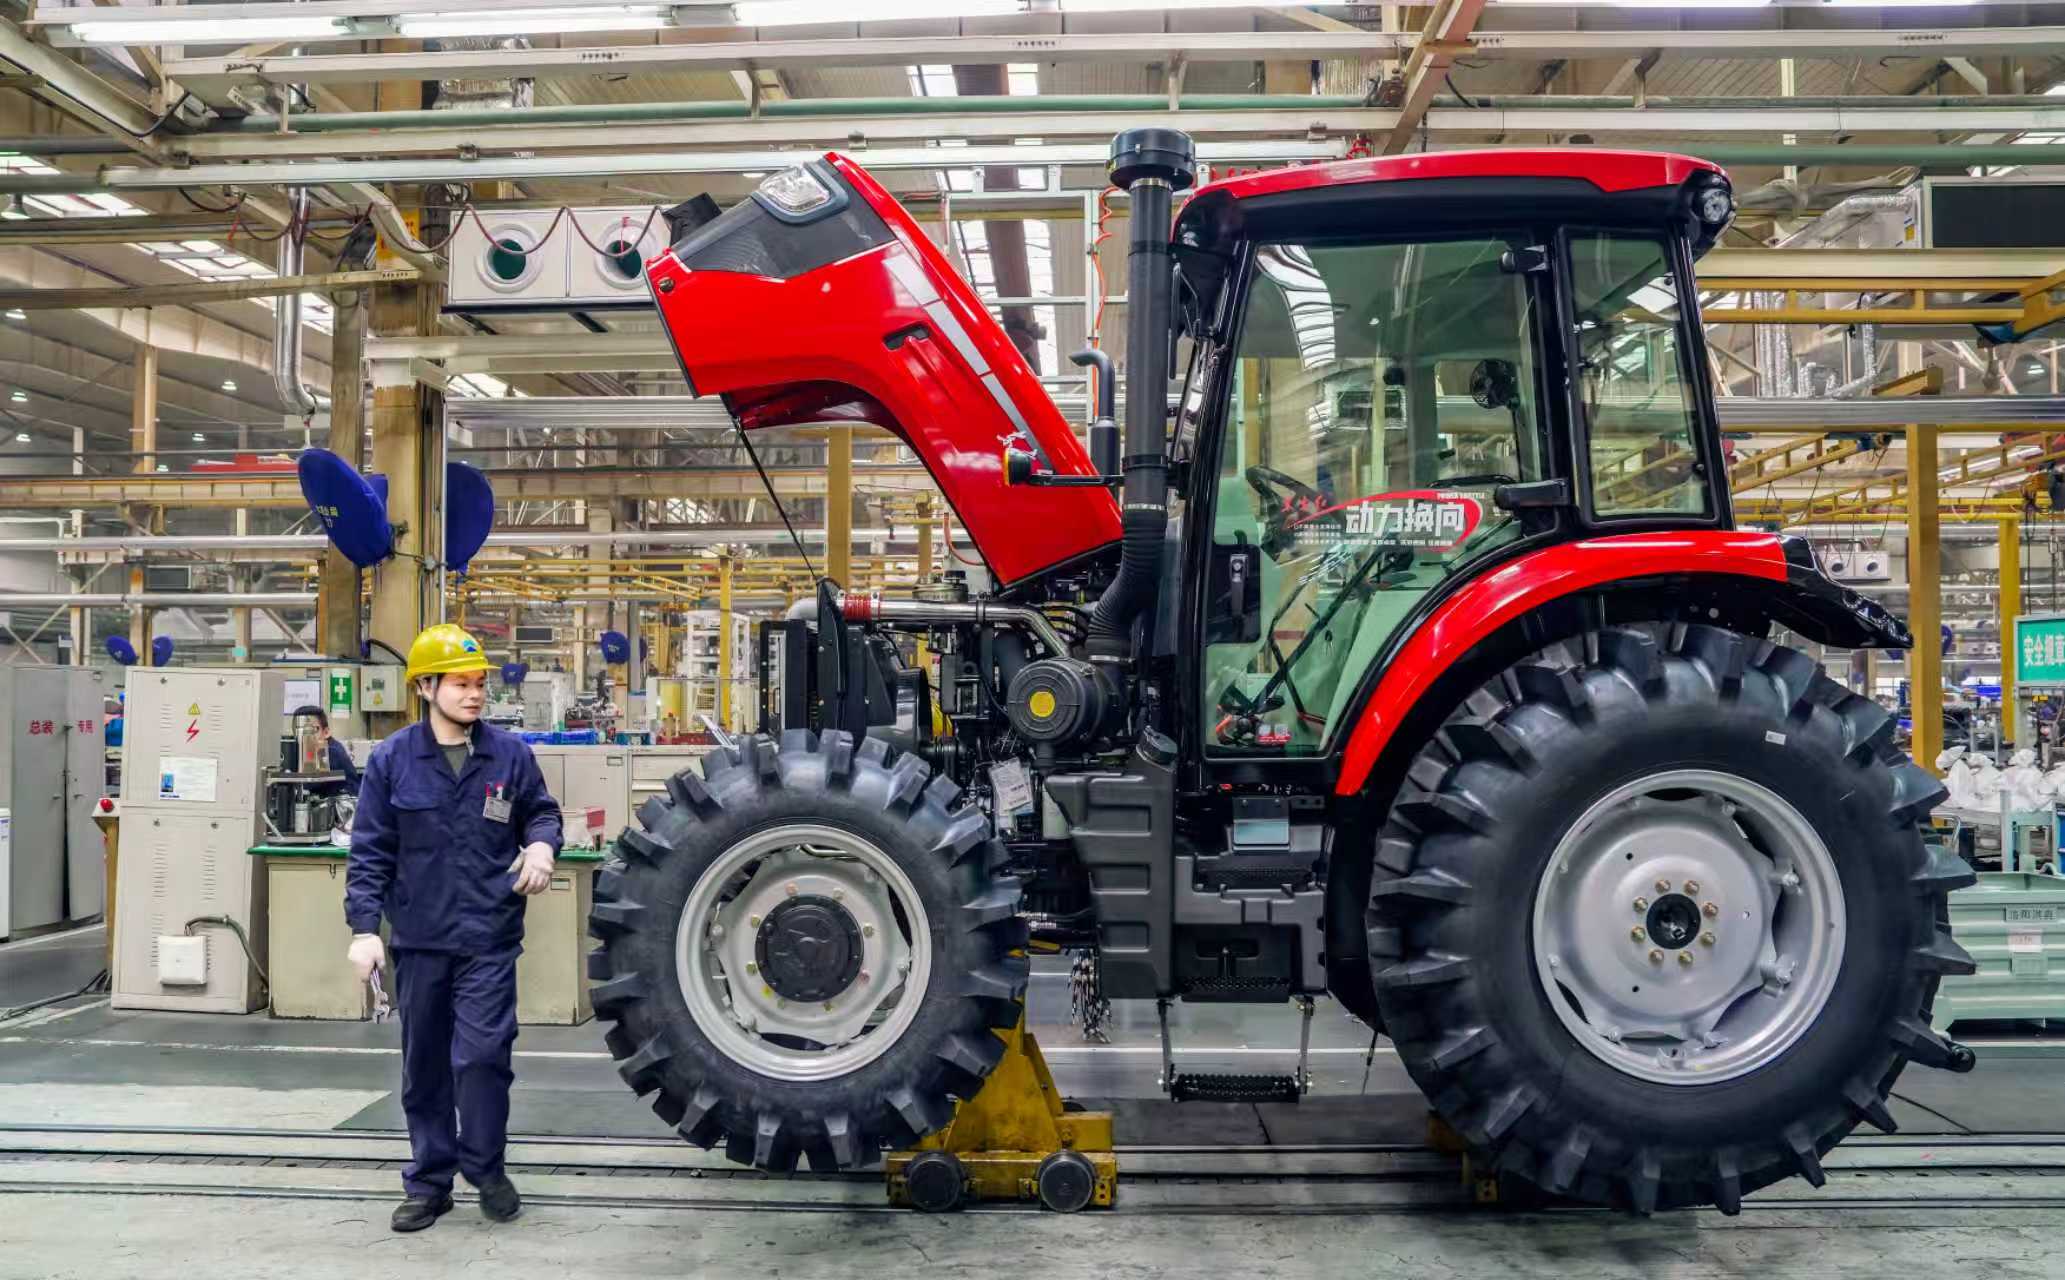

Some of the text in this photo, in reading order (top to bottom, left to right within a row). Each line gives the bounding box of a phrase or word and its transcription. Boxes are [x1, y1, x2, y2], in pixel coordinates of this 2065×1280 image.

[1345, 500, 1464, 537] 动力换向
[29, 719, 54, 736] 总装
